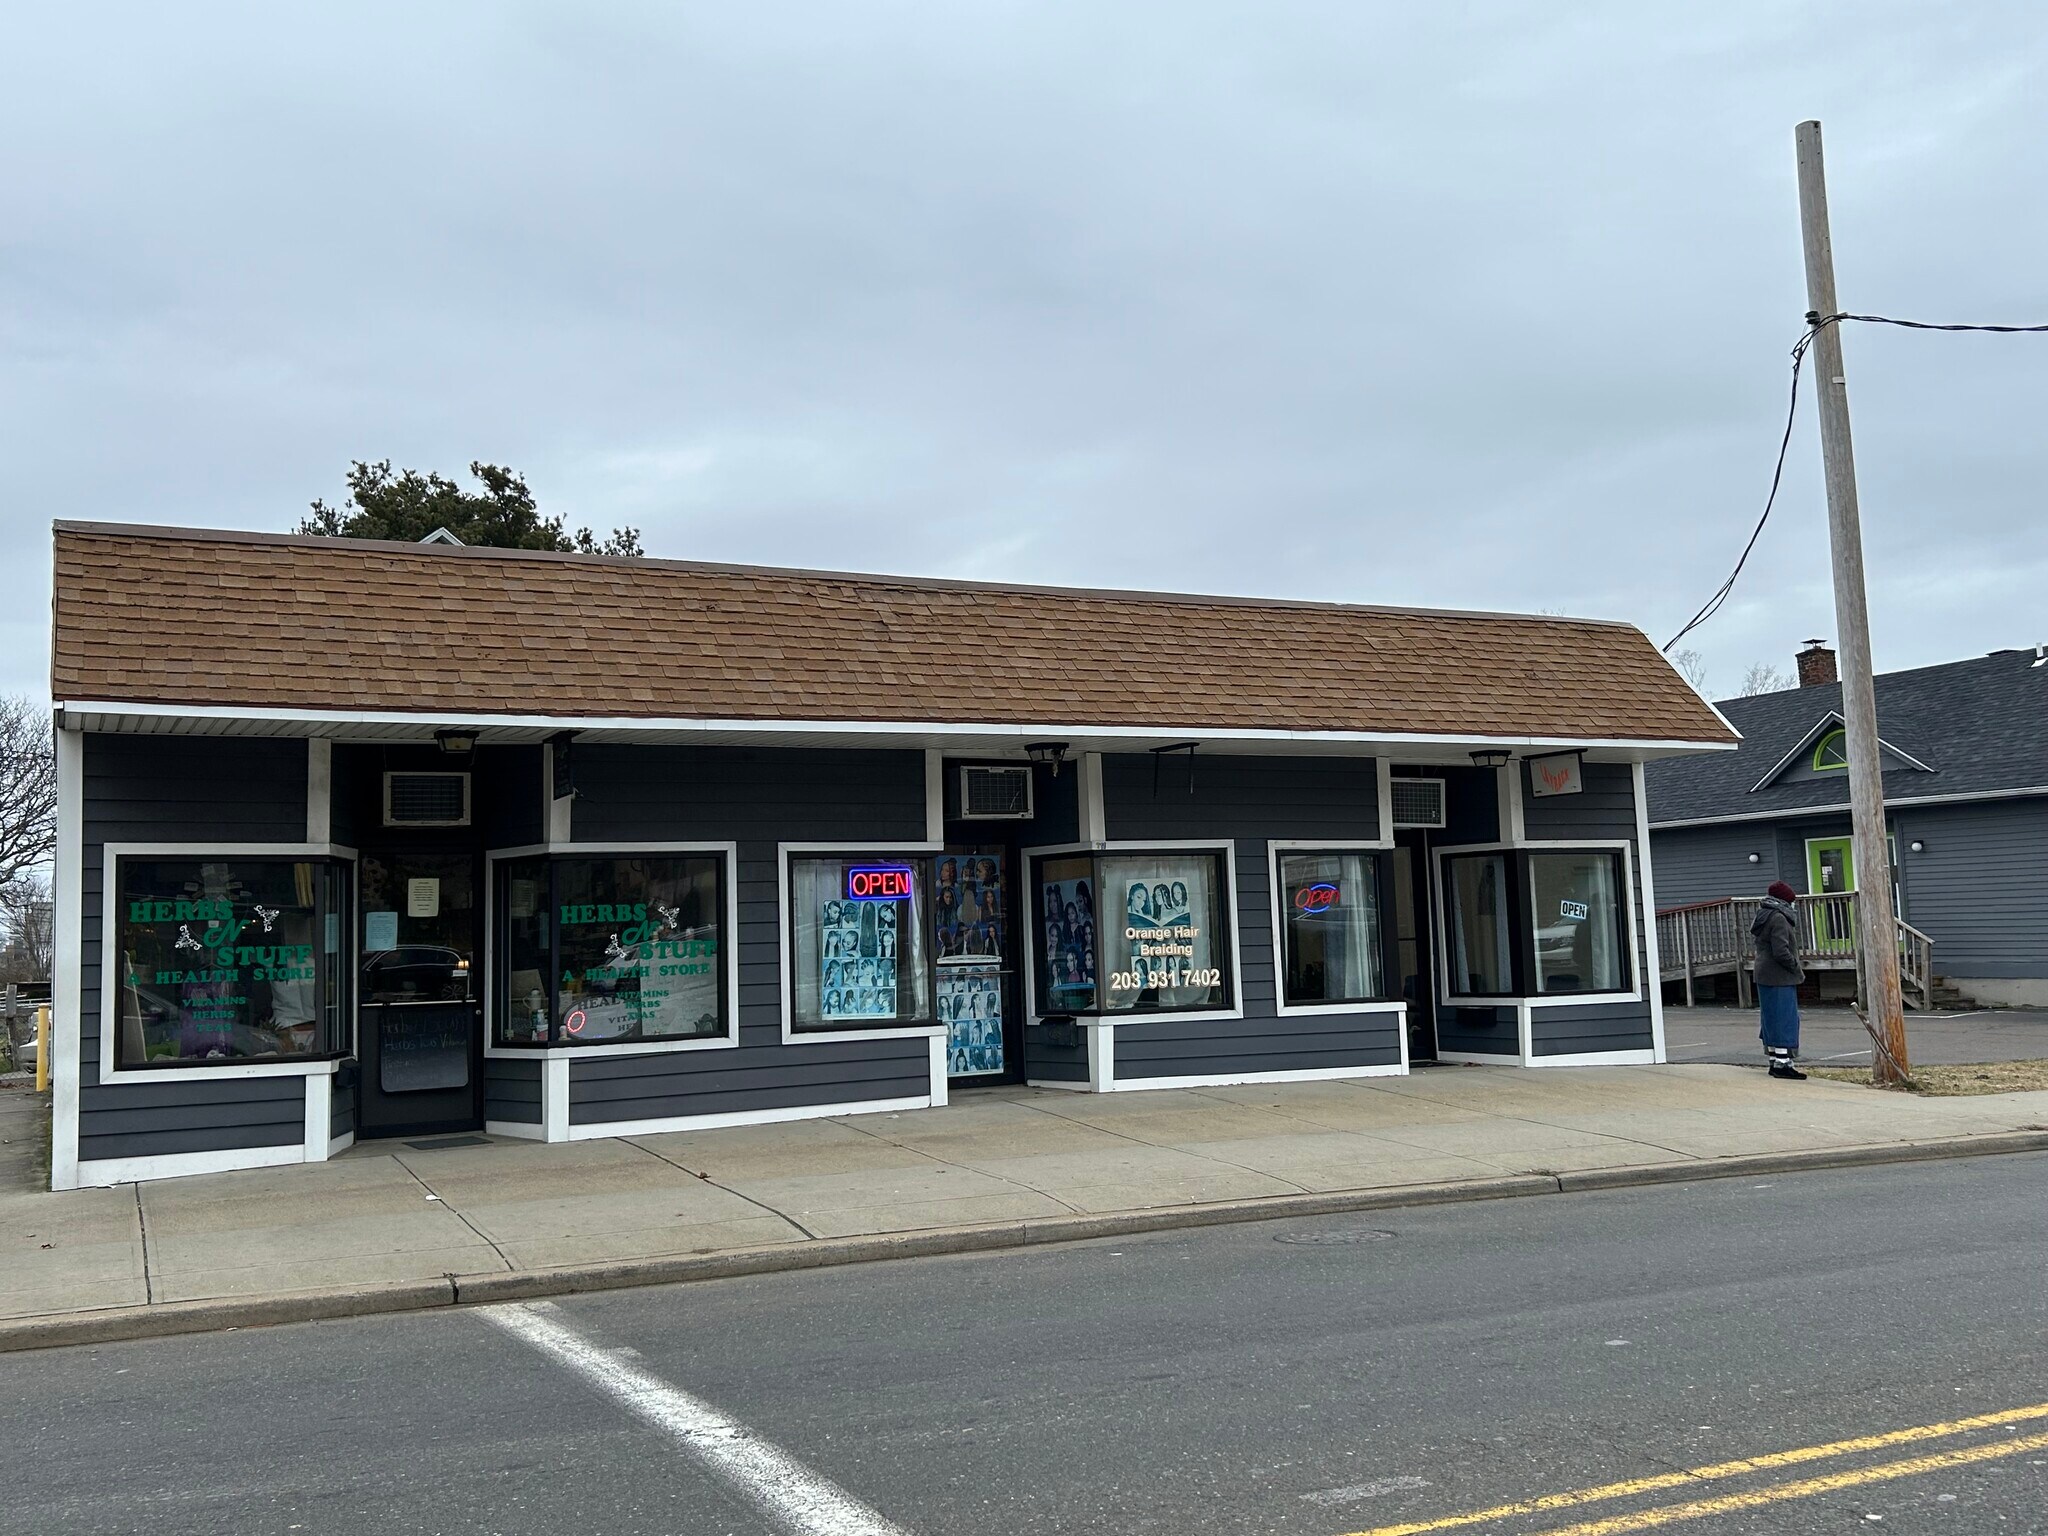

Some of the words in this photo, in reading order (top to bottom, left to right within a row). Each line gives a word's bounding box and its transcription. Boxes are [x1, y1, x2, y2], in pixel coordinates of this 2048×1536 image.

[852, 873, 909, 896] OPEN
[1295, 887, 1340, 909] Open
[130, 901, 232, 922] HERBS
[560, 904, 646, 923] HERBS
[1562, 902, 1586, 918] OPEN
[204, 919, 249, 947] N
[621, 919, 662, 945] N
[1125, 926, 1171, 941] Orange
[1174, 926, 1200, 939] Hair
[217, 945, 312, 966] STUFF
[639, 940, 717, 960] STUFF
[1140, 943, 1193, 957] Braiding
[156, 969, 239, 985] HEALTH
[253, 967, 316, 982] STORE
[562, 970, 574, 981] A
[586, 967, 650, 980] HEALTH
[659, 964, 710, 976] STORE
[1111, 972, 1142, 990] 203
[1149, 971, 1176, 989] 931
[1181, 968, 1221, 987] 7402
[183, 996, 246, 1006] VITAMINS
[616, 990, 669, 999] VITAMINS
[193, 1010, 236, 1019] HERBS
[196, 1023, 232, 1033] TEAS
